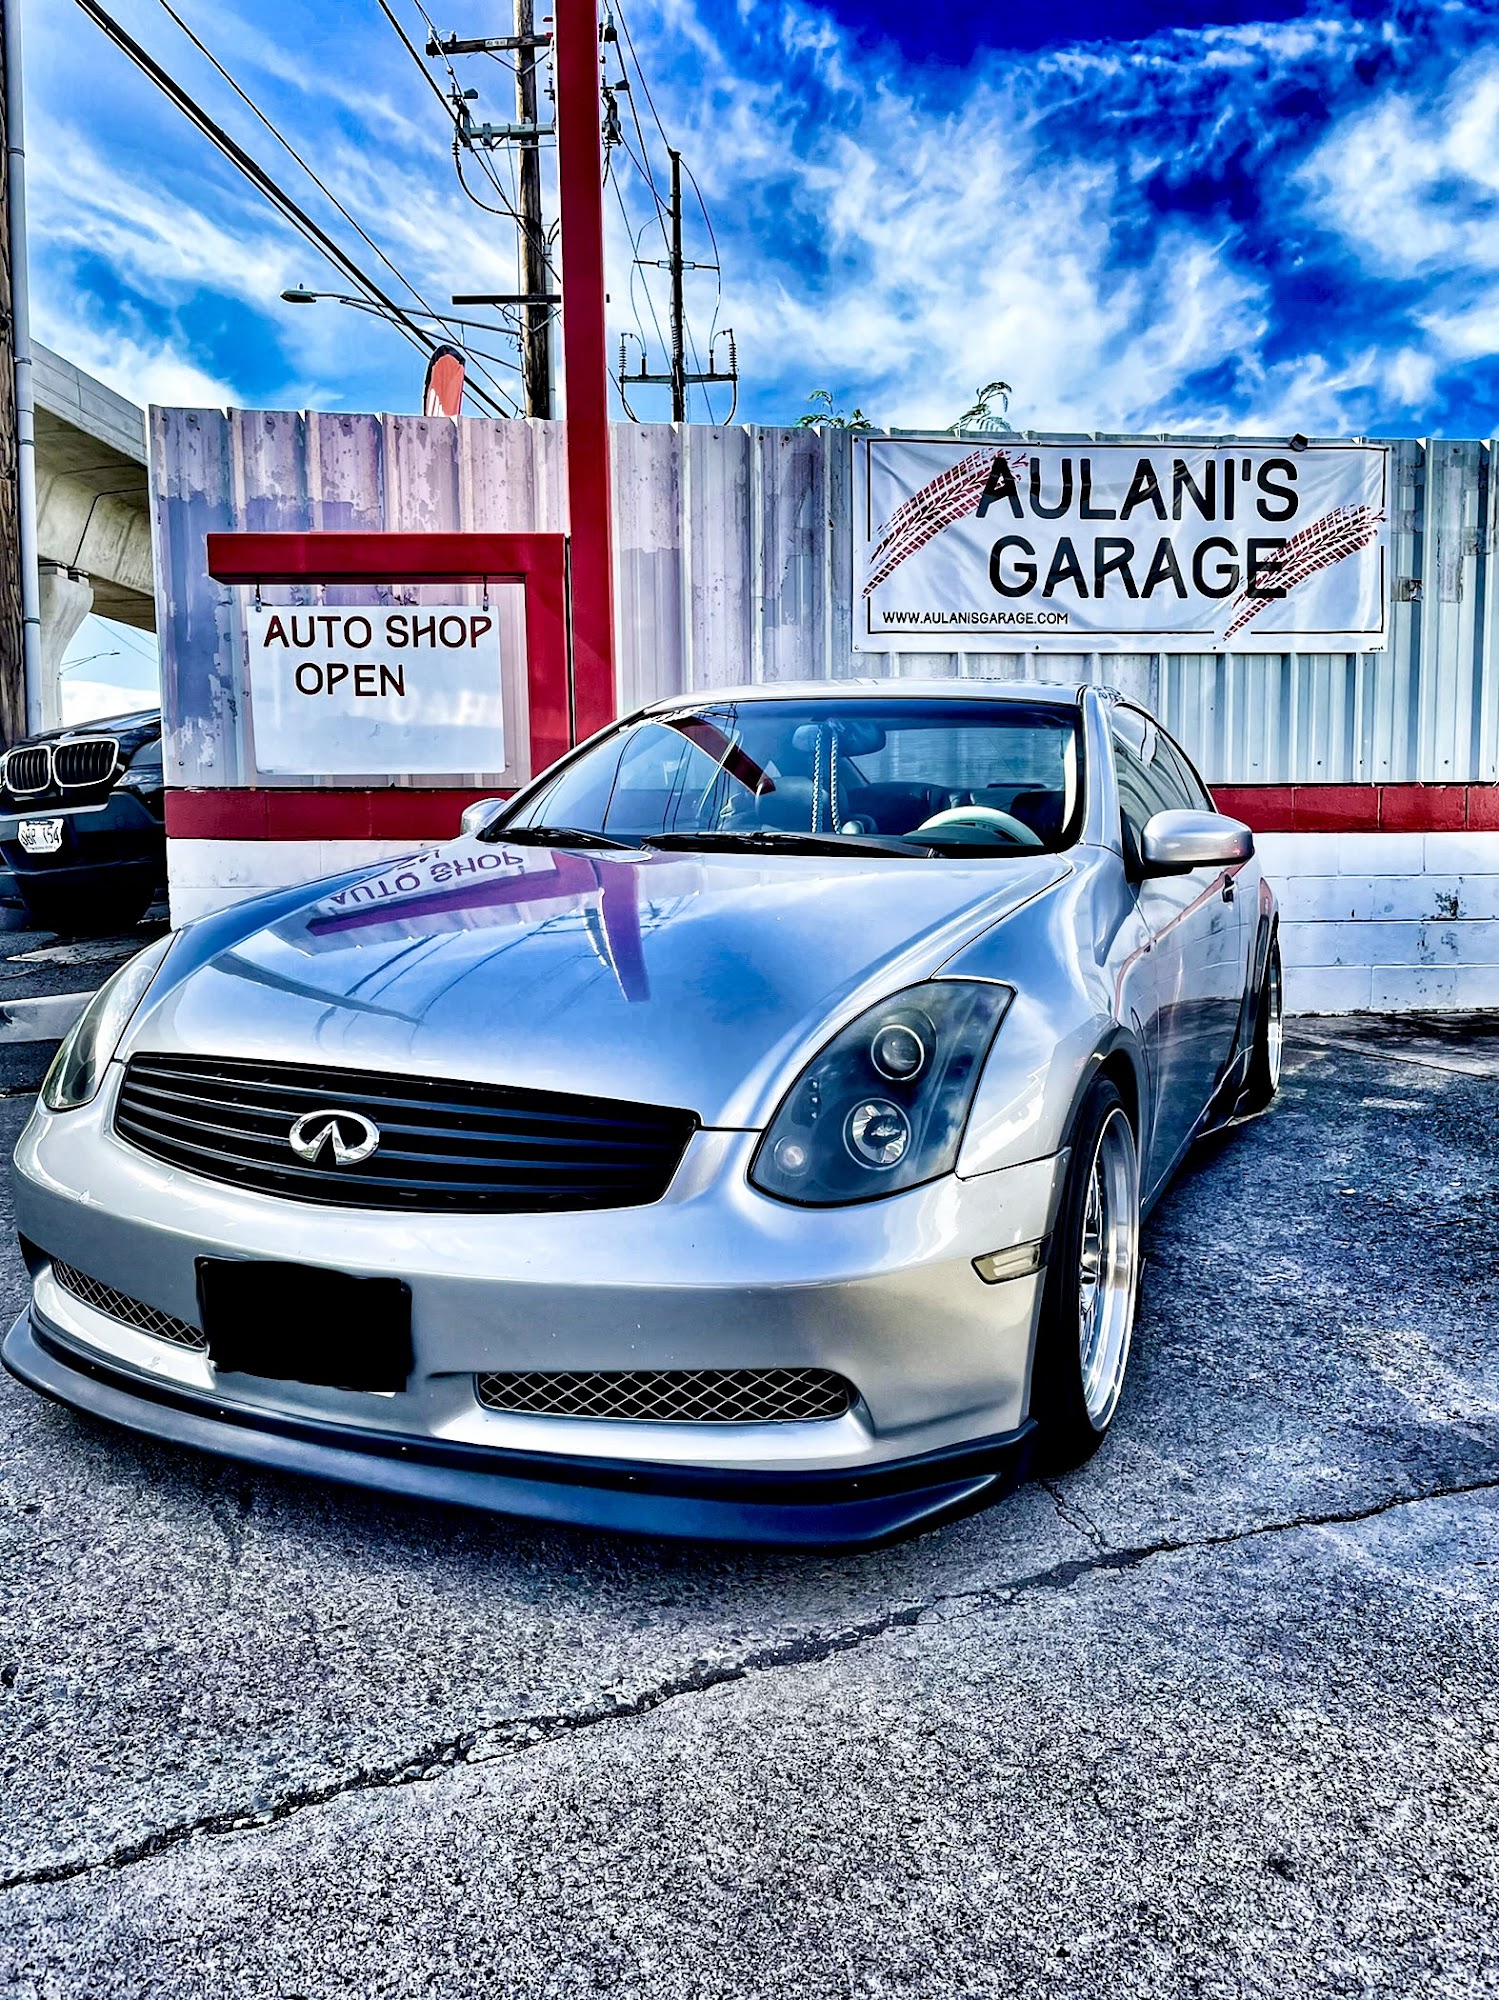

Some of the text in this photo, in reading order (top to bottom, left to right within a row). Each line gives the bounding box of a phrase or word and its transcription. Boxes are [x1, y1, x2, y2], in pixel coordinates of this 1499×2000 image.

[975, 457, 1300, 521] AULANI'S
[989, 535, 1288, 600] GARAGE
[263, 615, 492, 649] AUTO SHOP
[882, 611, 1069, 625] WWW.AULANISGARAGE.COM
[295, 662, 406, 697] OPEN
